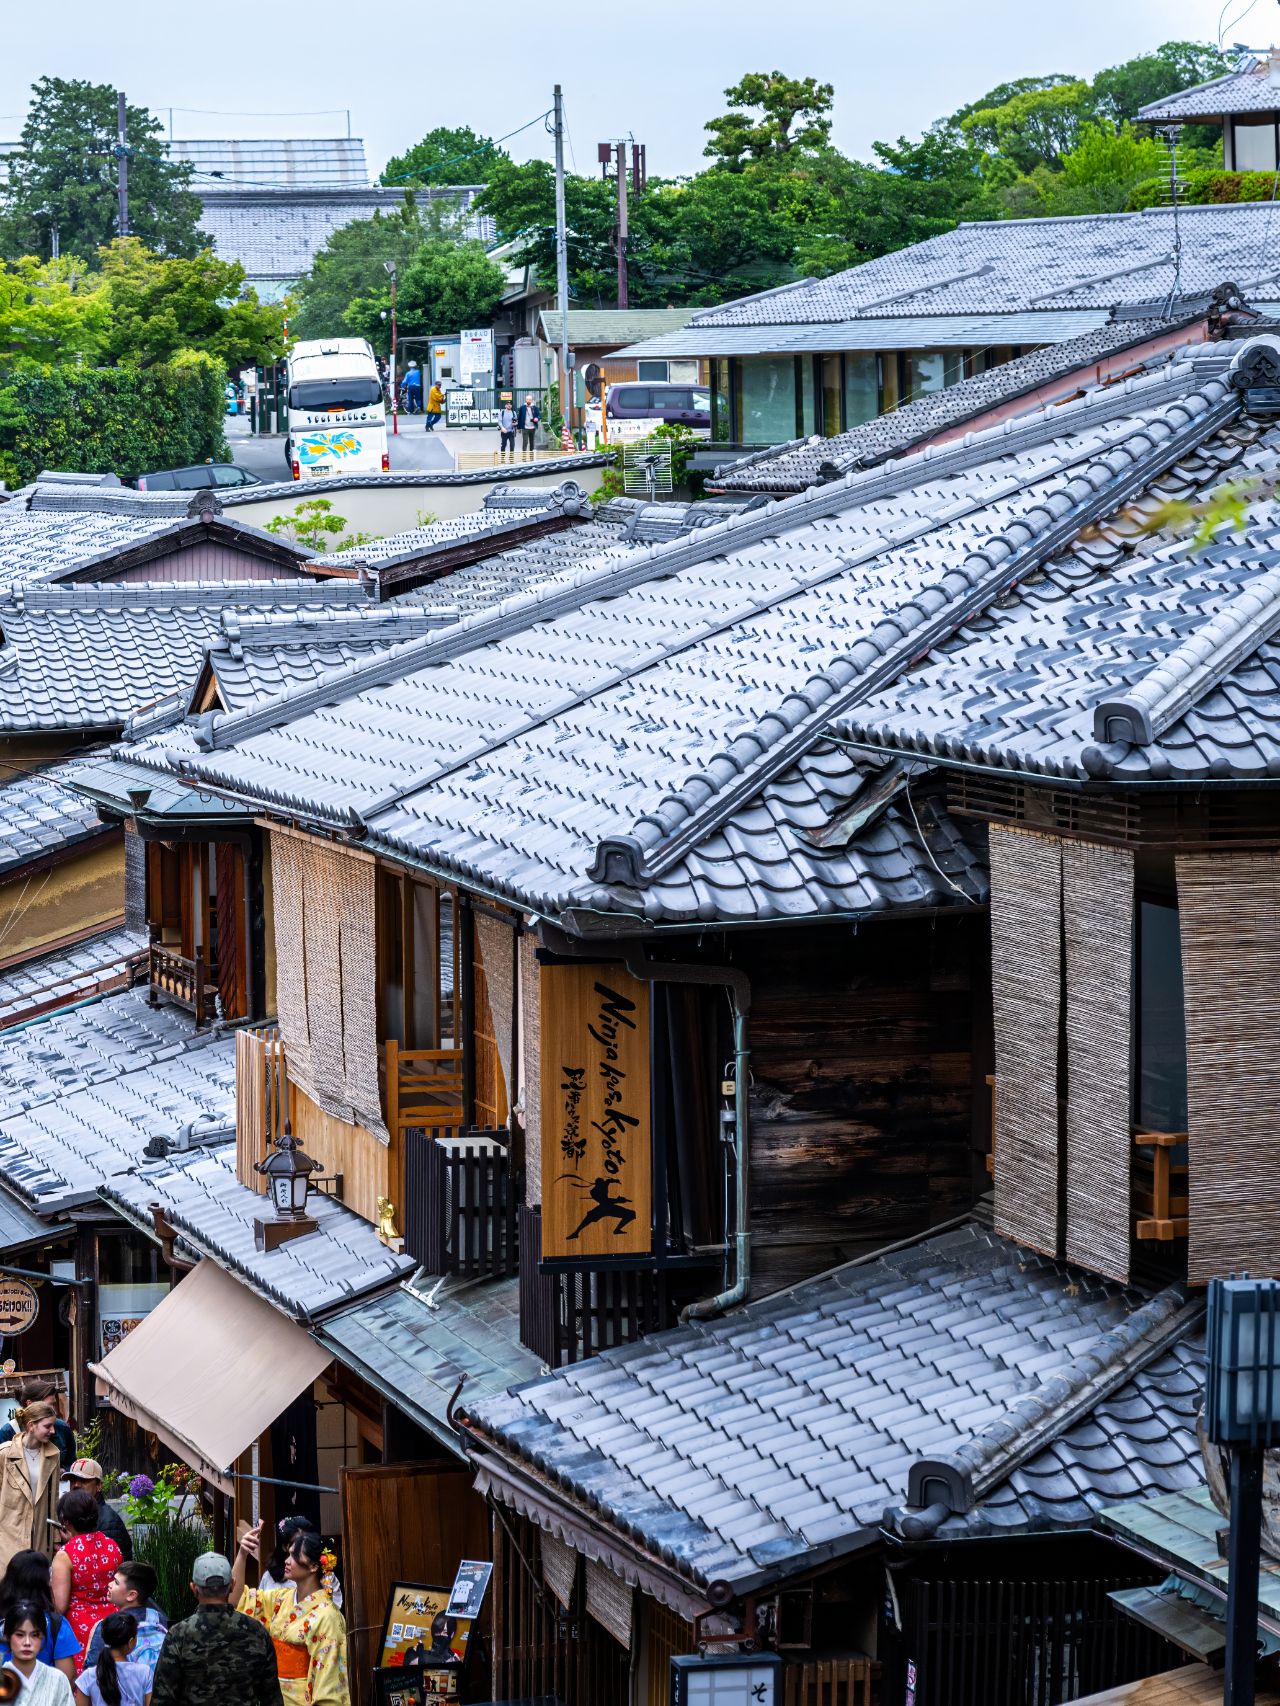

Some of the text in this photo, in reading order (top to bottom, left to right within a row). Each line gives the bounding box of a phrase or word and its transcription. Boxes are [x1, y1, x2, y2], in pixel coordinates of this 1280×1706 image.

[449, 411, 499, 421] 歩行出入禁
[587, 981, 637, 1061] Ninja
[590, 1107, 640, 1175] Kyoto
